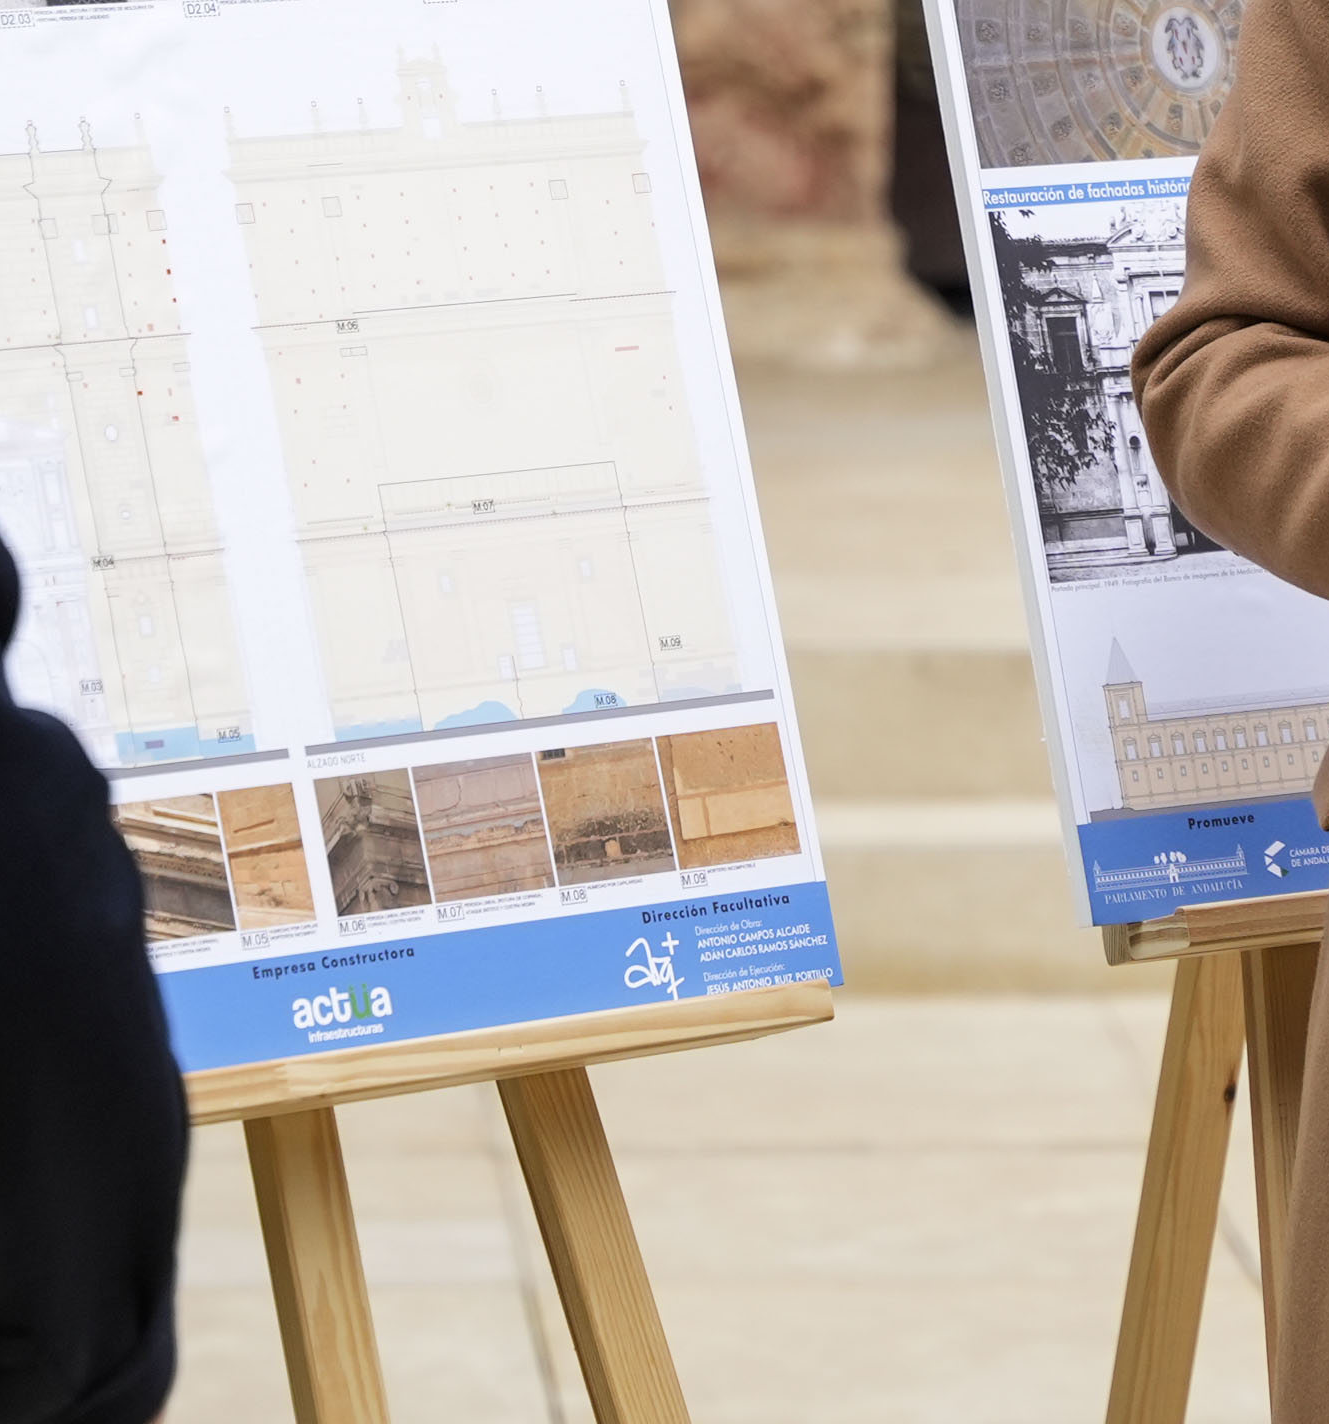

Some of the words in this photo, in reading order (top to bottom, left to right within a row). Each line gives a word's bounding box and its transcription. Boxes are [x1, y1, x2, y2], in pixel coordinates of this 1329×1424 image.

[187, 3, 216, 15] D2.04
[0, 13, 31, 26] D2.03
[983, 185, 1065, 206] Restauración
[1068, 183, 1084, 200] de
[1087, 180, 1145, 198] fachadas
[1188, 812, 1254, 830] Promueve
[1289, 846, 1320, 858] CÁMARA
[1292, 858, 1302, 868] DE
[682, 872, 706, 887] M.09
[561, 887, 586, 902] M.08
[1105, 888, 1167, 904] PARLAMENTO
[1172, 886, 1185, 897] DE
[1192, 878, 1243, 894] ANDALUCÍA
[437, 904, 462, 920] M.07
[642, 904, 707, 925] Dirección
[713, 893, 790, 915] Facultativa
[339, 919, 365, 935] M.06
[695, 923, 728, 936] Dirección
[730, 922, 739, 931] de
[242, 933, 269, 948] M.05
[698, 934, 737, 949] ANTONIO
[739, 929, 774, 943] CAMPOS
[776, 924, 810, 937] ALCAIDE
[726, 946, 757, 959] CARLOS
[759, 941, 787, 954] RAMOS
[789, 935, 828, 950] SÁNCHEZ
[252, 961, 316, 981] Empresa
[322, 946, 415, 970] Constructora
[703, 969, 737, 982] Dirección
[739, 967, 748, 976] de
[706, 982, 730, 995] JESÚS
[732, 977, 771, 991] ANTONIO
[775, 972, 793, 985] RUIZ
[797, 968, 833, 981] PORTILLO
[309, 1022, 384, 1043] infraestructuras
